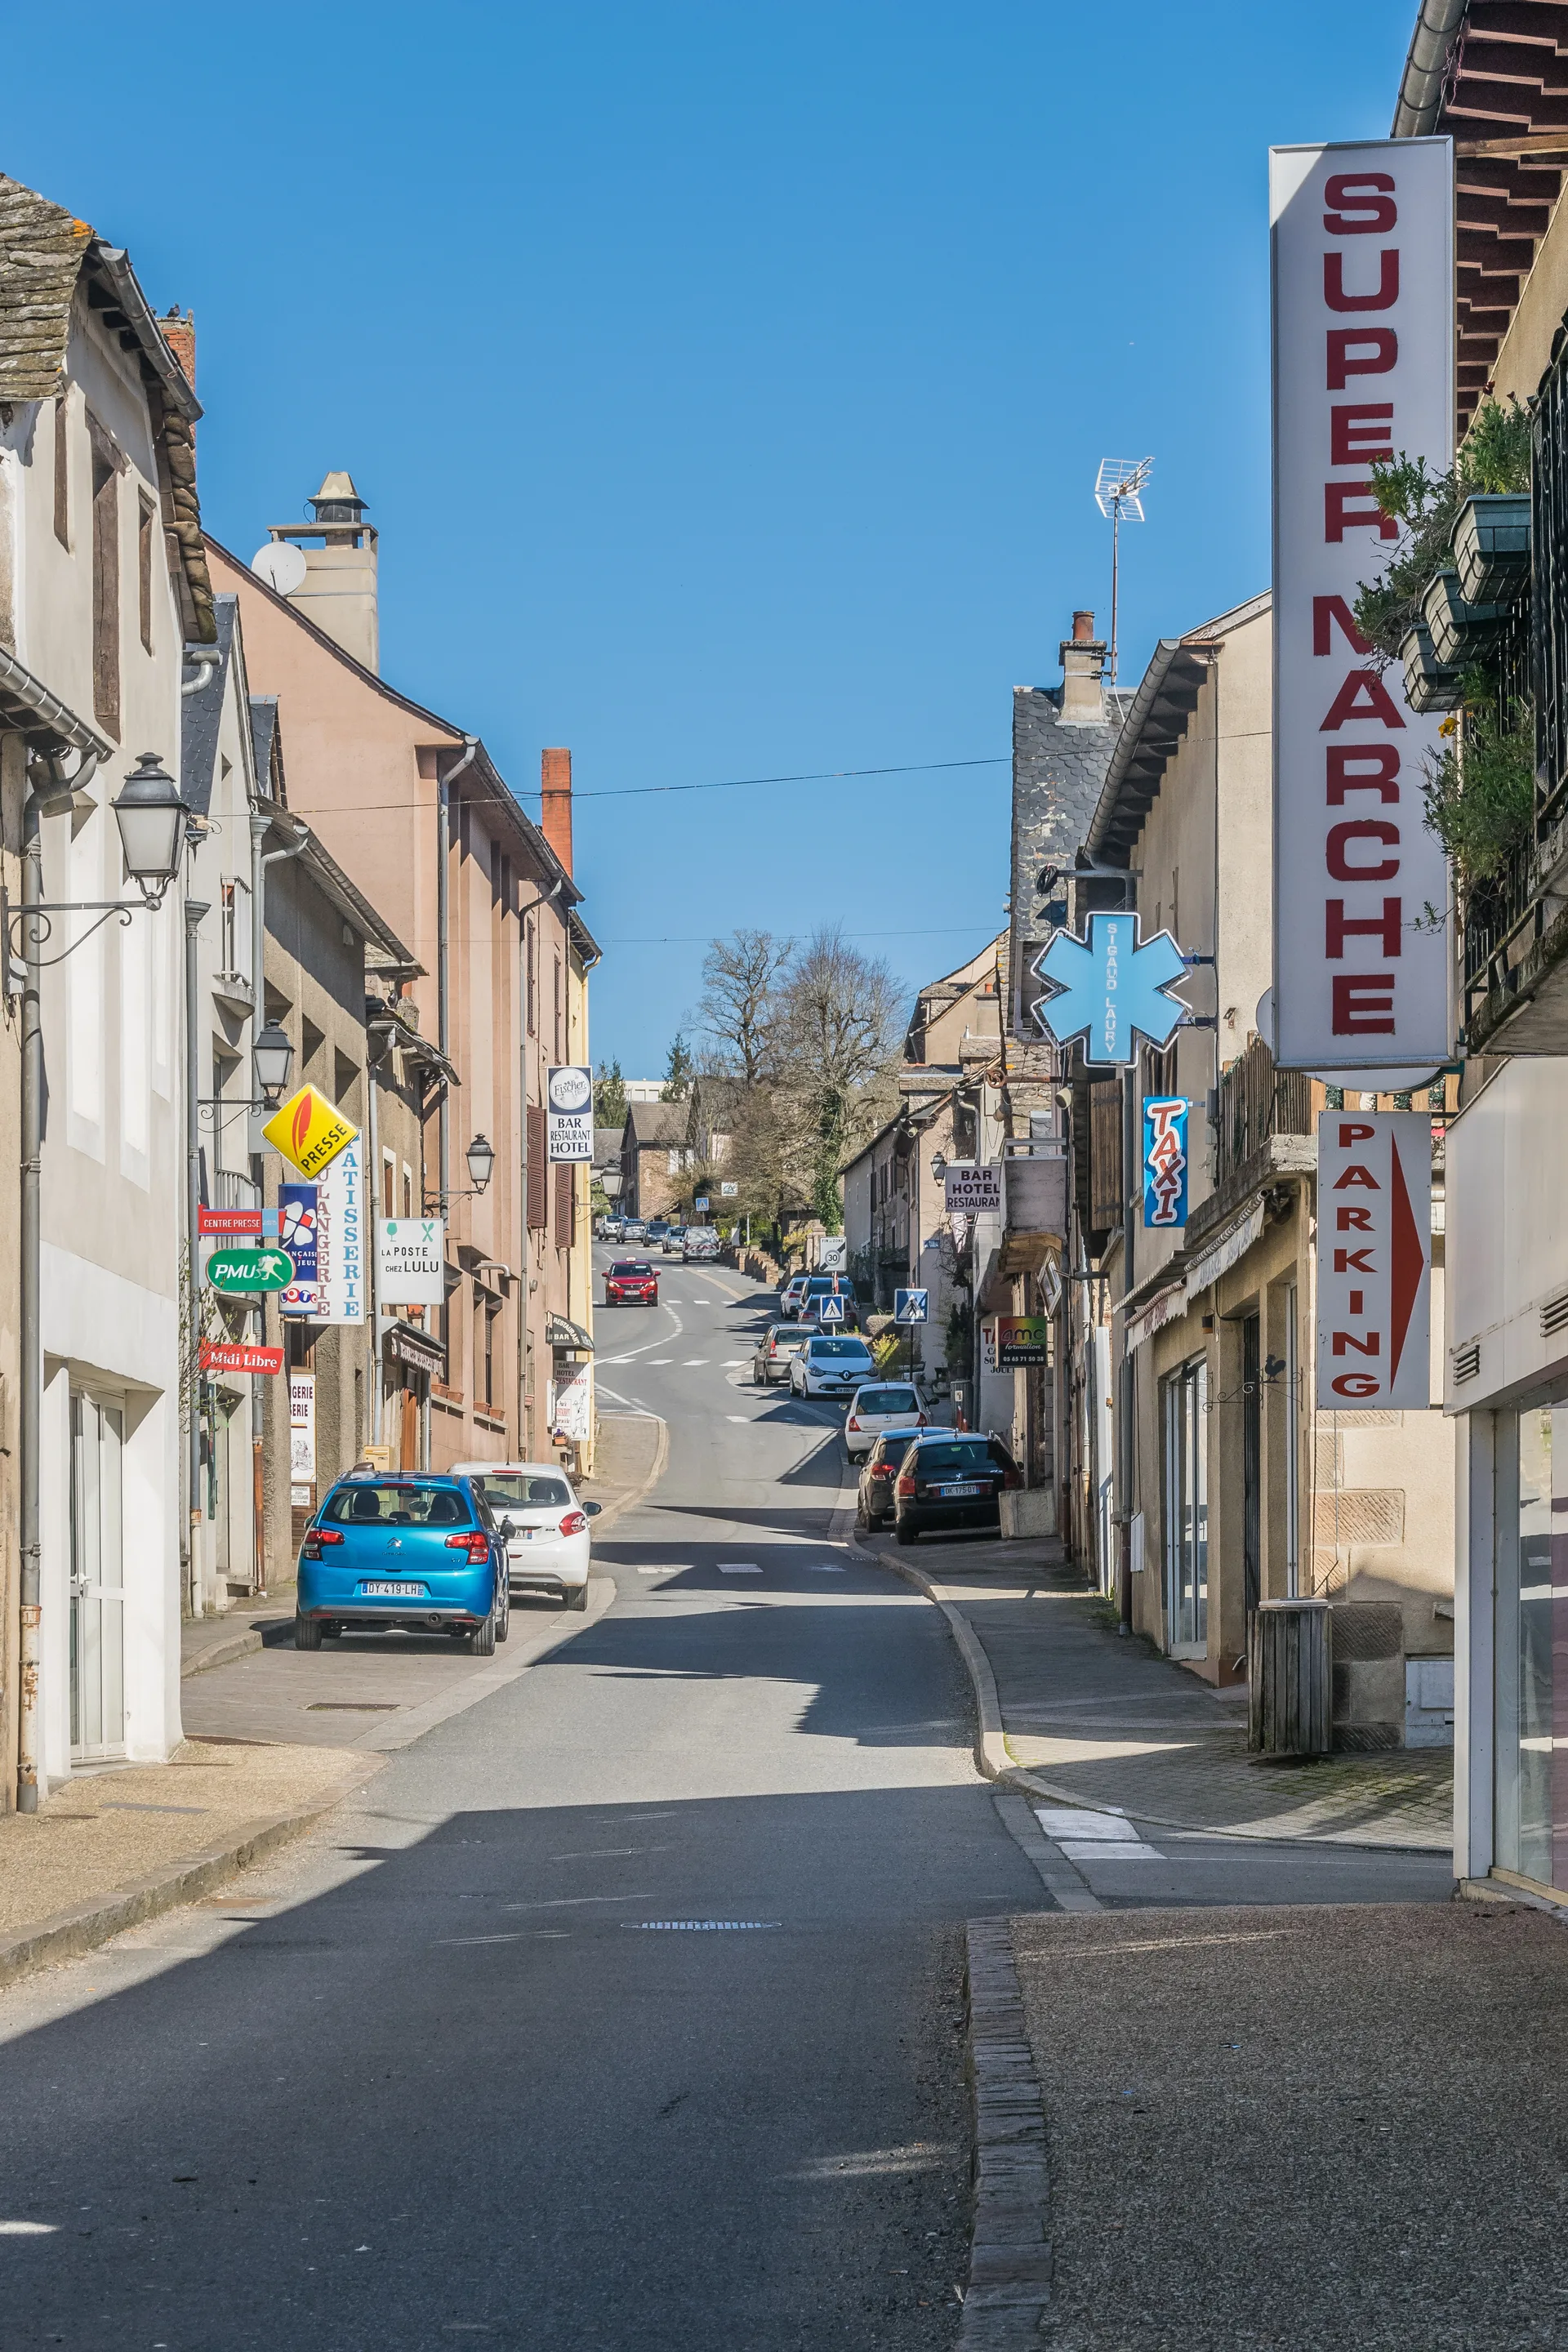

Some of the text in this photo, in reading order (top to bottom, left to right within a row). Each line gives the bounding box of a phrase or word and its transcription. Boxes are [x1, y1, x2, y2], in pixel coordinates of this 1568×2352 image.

[1106, 923, 1118, 991] SIGAUD
[1105, 996, 1116, 1054] LAURY
[558, 1117, 581, 1129] BAR
[550, 1129, 590, 1141] RESTAURANT
[300, 1123, 347, 1171] PRESSE
[550, 1142, 591, 1153] HOTEL
[1151, 1102, 1183, 1221] TAXI
[960, 1170, 992, 1181] BAR
[952, 1183, 1000, 1194] HOTEL
[947, 1196, 1000, 1208] RESTAURAN
[204, 1219, 232, 1228] CENTRE
[233, 1218, 261, 1228] PRESSE
[316, 1168, 332, 1316] ULANGERIE
[394, 1246, 429, 1256] POSTE
[404, 1261, 439, 1272] LULU
[1331, 1122, 1382, 1399] PARKING
[215, 1264, 256, 1279] PMU
[280, 1288, 318, 1304] LOTO
[553, 1316, 581, 1345] RESTAURANT
[1005, 1342, 1042, 1350] formation
[210, 1351, 278, 1368] Midi Libre
[291, 1386, 314, 1399] GERIE
[291, 1404, 309, 1417] ERIE
[368, 1583, 417, 1595] DY-419-LH
